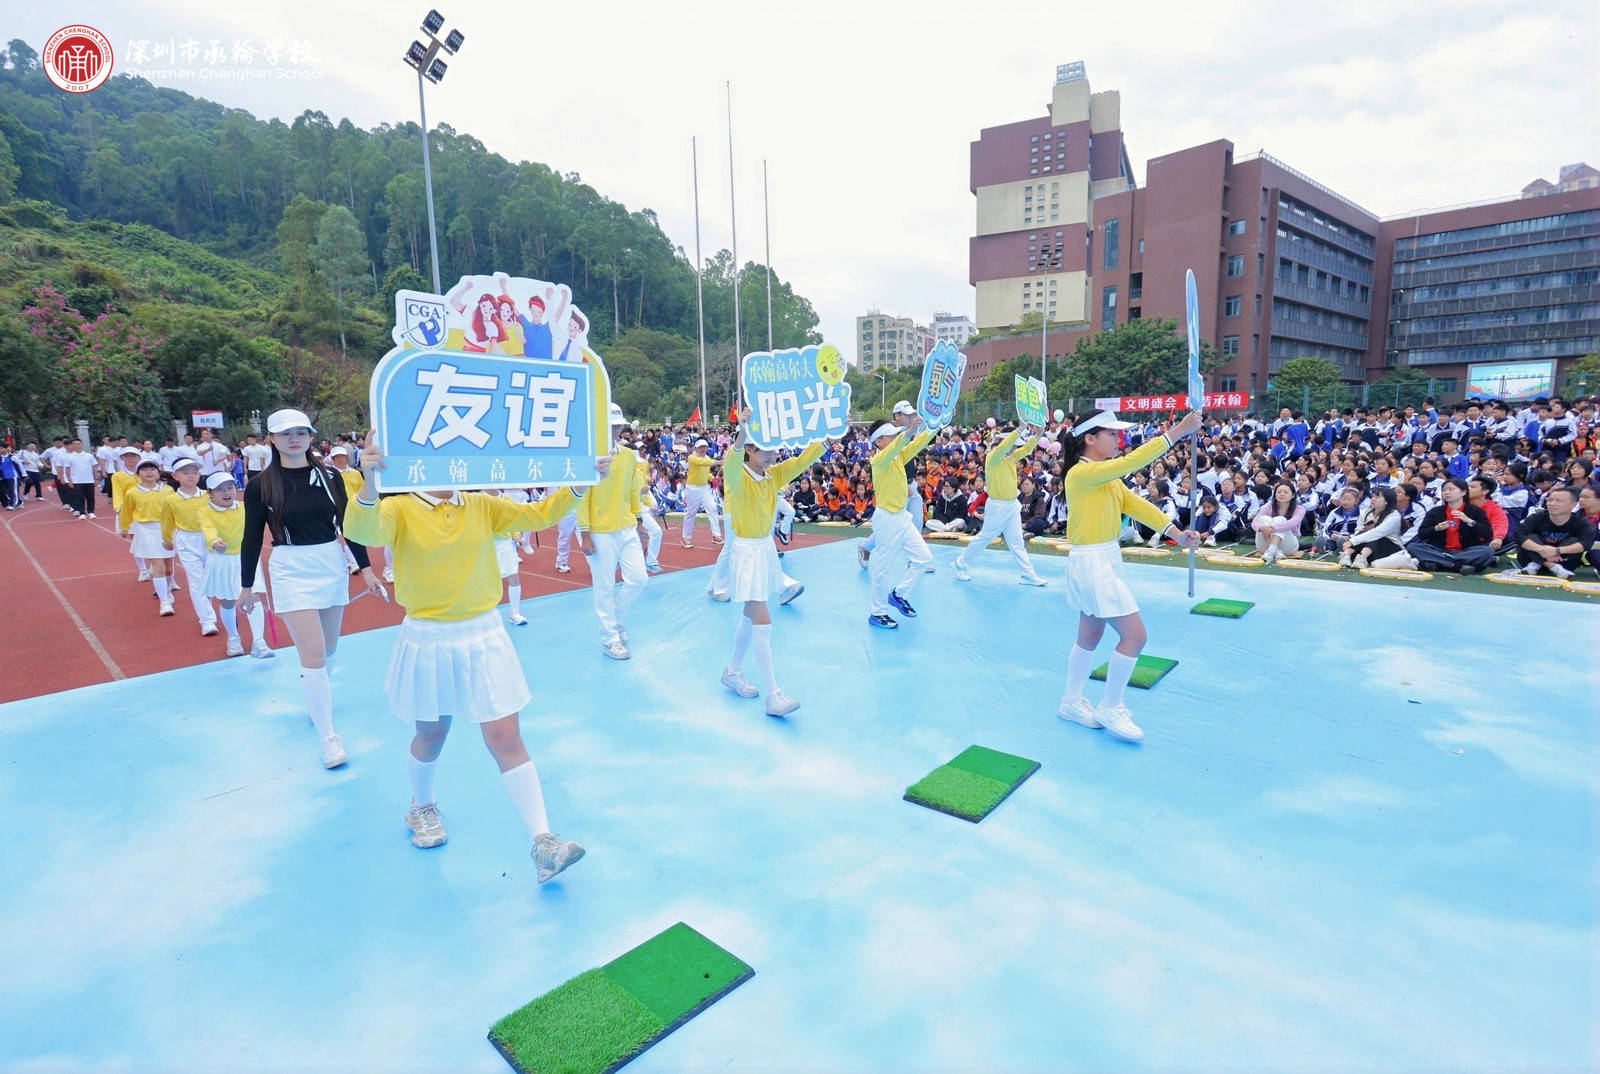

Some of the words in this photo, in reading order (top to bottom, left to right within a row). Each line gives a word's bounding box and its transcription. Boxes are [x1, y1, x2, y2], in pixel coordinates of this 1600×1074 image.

[408, 304, 442, 319] CGA
[749, 357, 814, 384] 承翰高尔夫
[409, 361, 577, 449] 友谊
[757, 382, 842, 443] 阳光
[1125, 397, 1177, 410] 文明盛会
[407, 458, 577, 484] 承翰高尔夫
